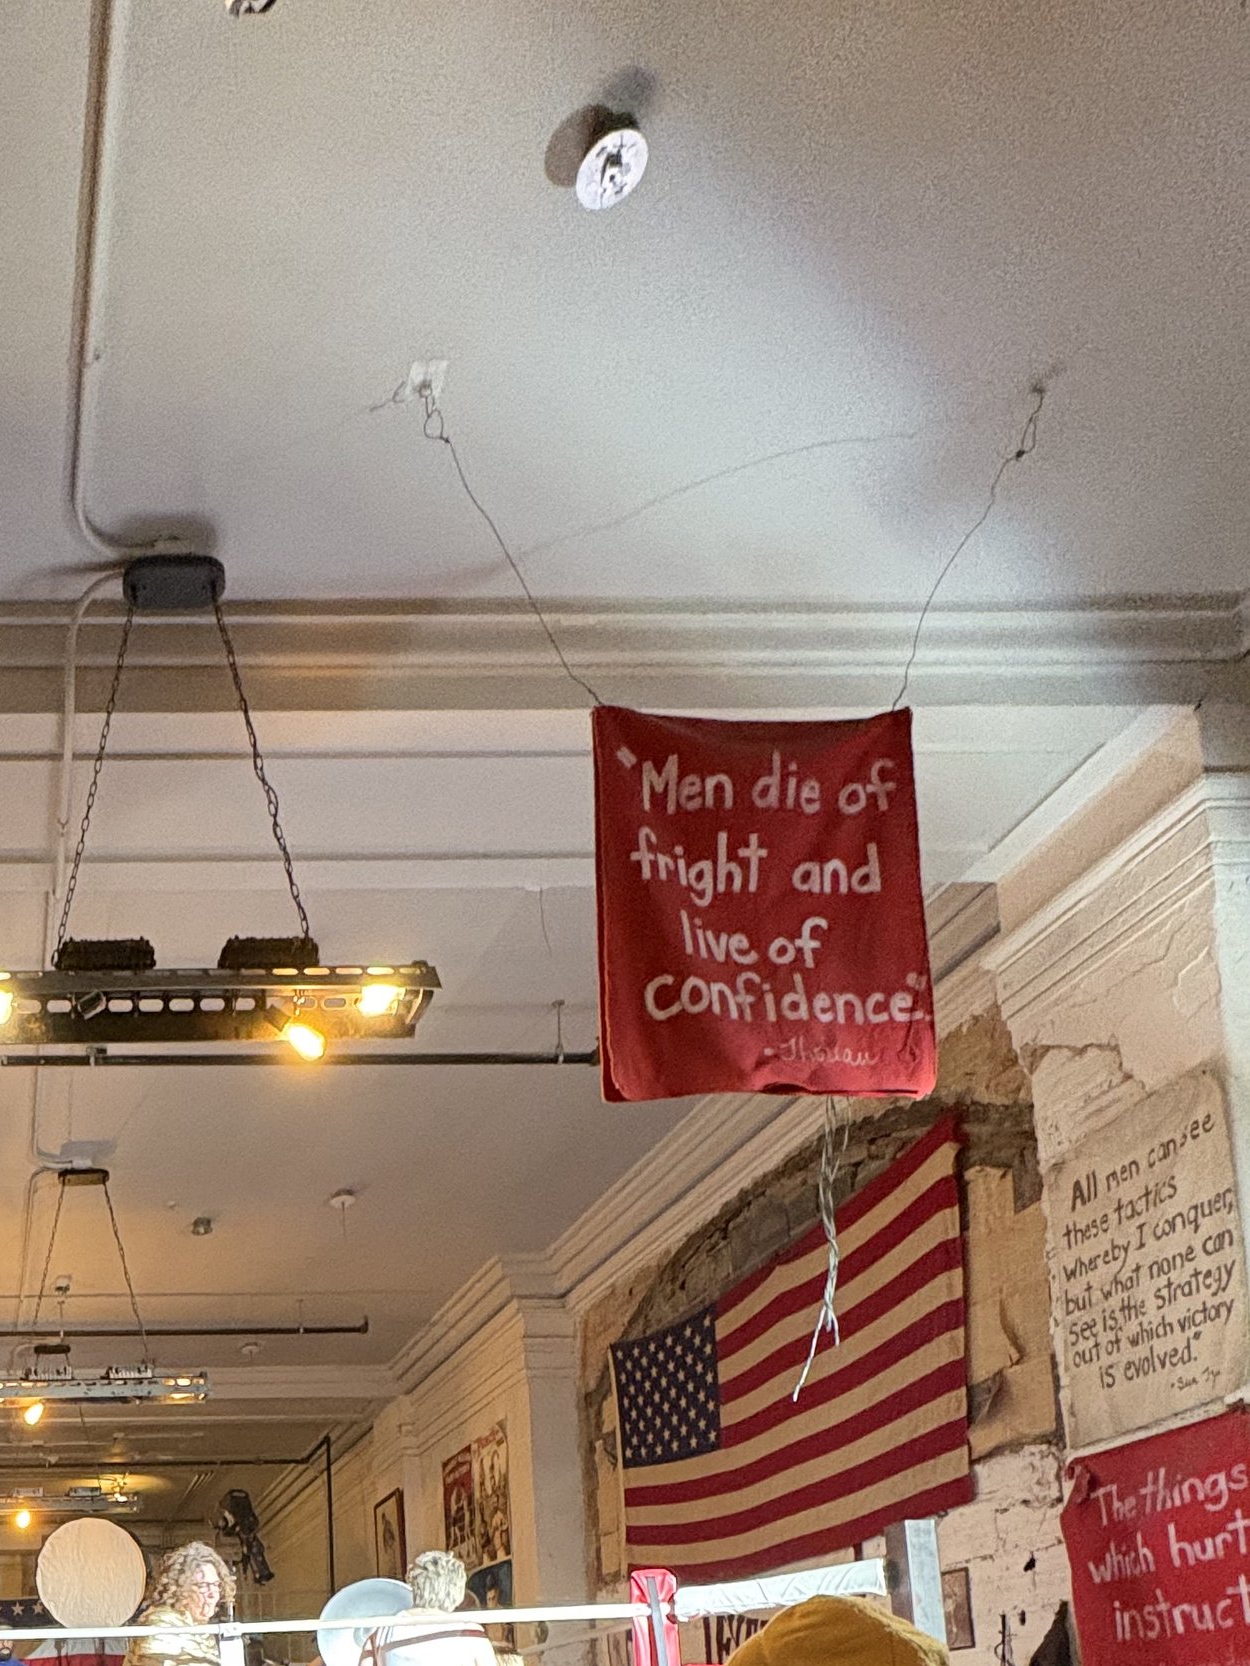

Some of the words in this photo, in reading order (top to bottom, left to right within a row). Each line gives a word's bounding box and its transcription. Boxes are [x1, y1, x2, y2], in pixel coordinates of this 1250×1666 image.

[752, 750, 821, 814] die
[838, 758, 896, 814] of
[631, 826, 768, 907] fright
[793, 843, 882, 894] and
[681, 910, 758, 965] live
[769, 917, 828, 968] of
[1071, 1170, 1096, 1212] All
[1106, 1160, 1139, 1192] men
[1148, 1138, 1177, 1168] can
[1063, 1213, 1109, 1250] these
[1114, 1175, 1177, 1225] tactics
[1135, 1222, 1146, 1250] I
[1154, 1188, 1234, 1240] conquer,
[1066, 1282, 1092, 1316] but
[1101, 1264, 1143, 1300] what
[1148, 1245, 1196, 1280] none
[1202, 1229, 1233, 1255] can
[1073, 1338, 1101, 1368] out
[1105, 1327, 1123, 1356] of
[1127, 1315, 1174, 1348] which
[1178, 1298, 1234, 1332] victory
[1102, 1309, 1118, 1332] is
[1121, 1297, 1147, 1323] the
[1099, 1366, 1116, 1389] is
[1091, 1484, 1136, 1526] The
[1139, 1463, 1248, 1515] things
[1088, 1531, 1155, 1584] which
[1168, 1509, 1250, 1568] hurt
